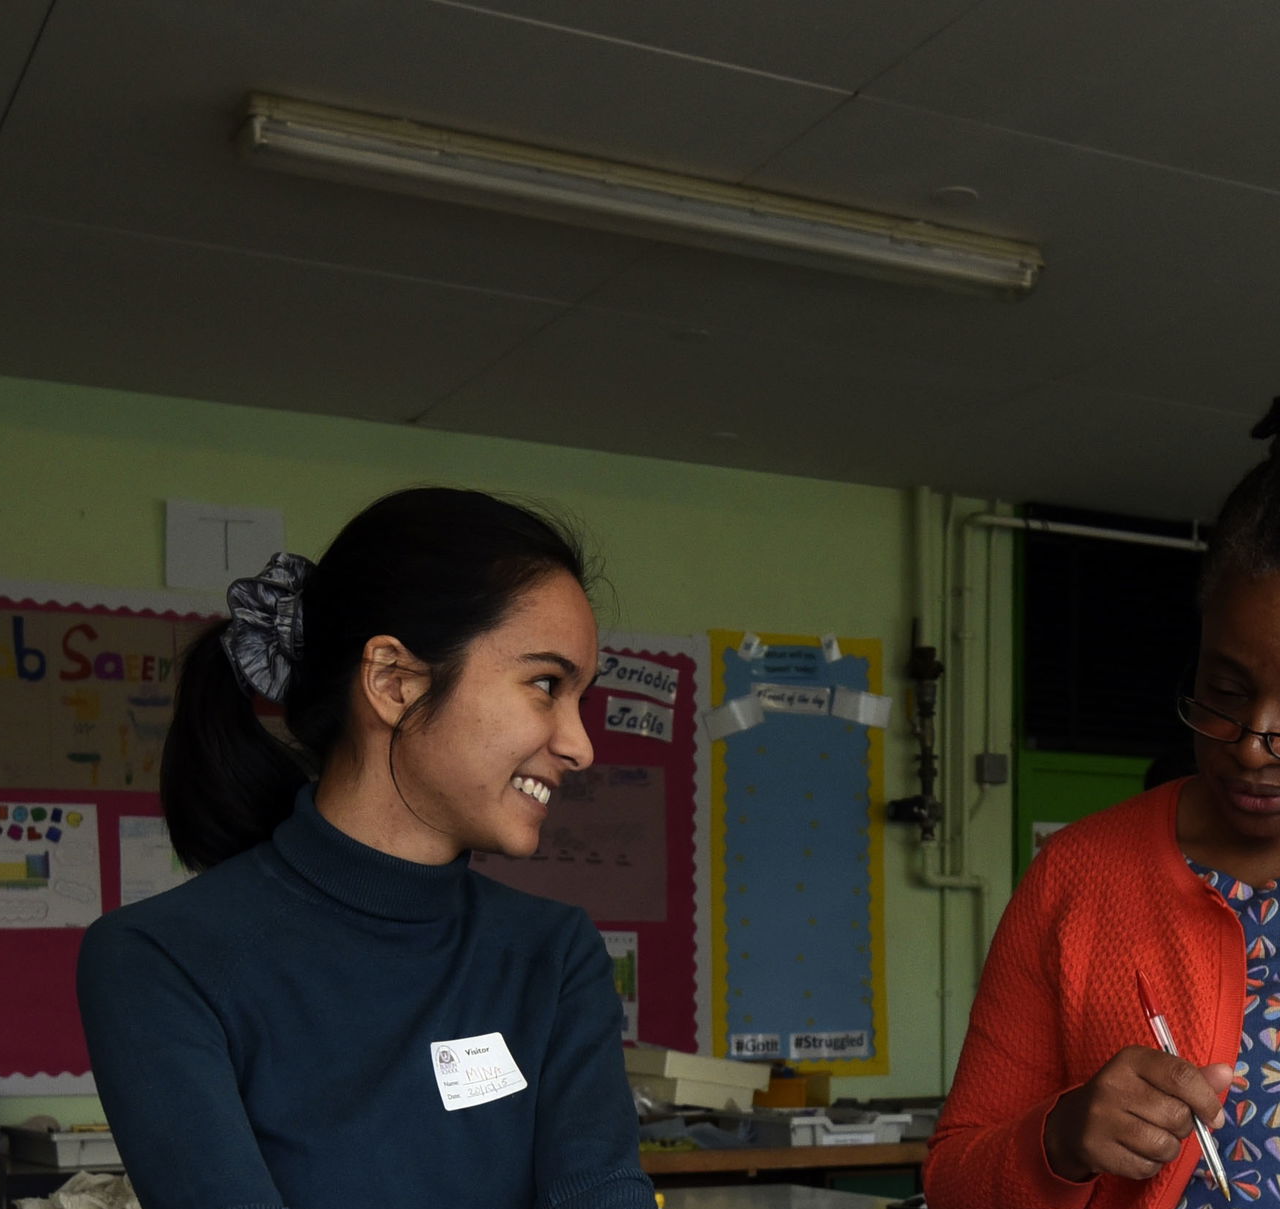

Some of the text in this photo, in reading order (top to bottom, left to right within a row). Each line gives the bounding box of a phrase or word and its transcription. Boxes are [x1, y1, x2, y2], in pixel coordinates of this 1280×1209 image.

[599, 657, 677, 693] Periodic
[608, 706, 664, 735] Table
[464, 1046, 490, 1057] Visitor
[794, 1030, 864, 1056] #Struggled
